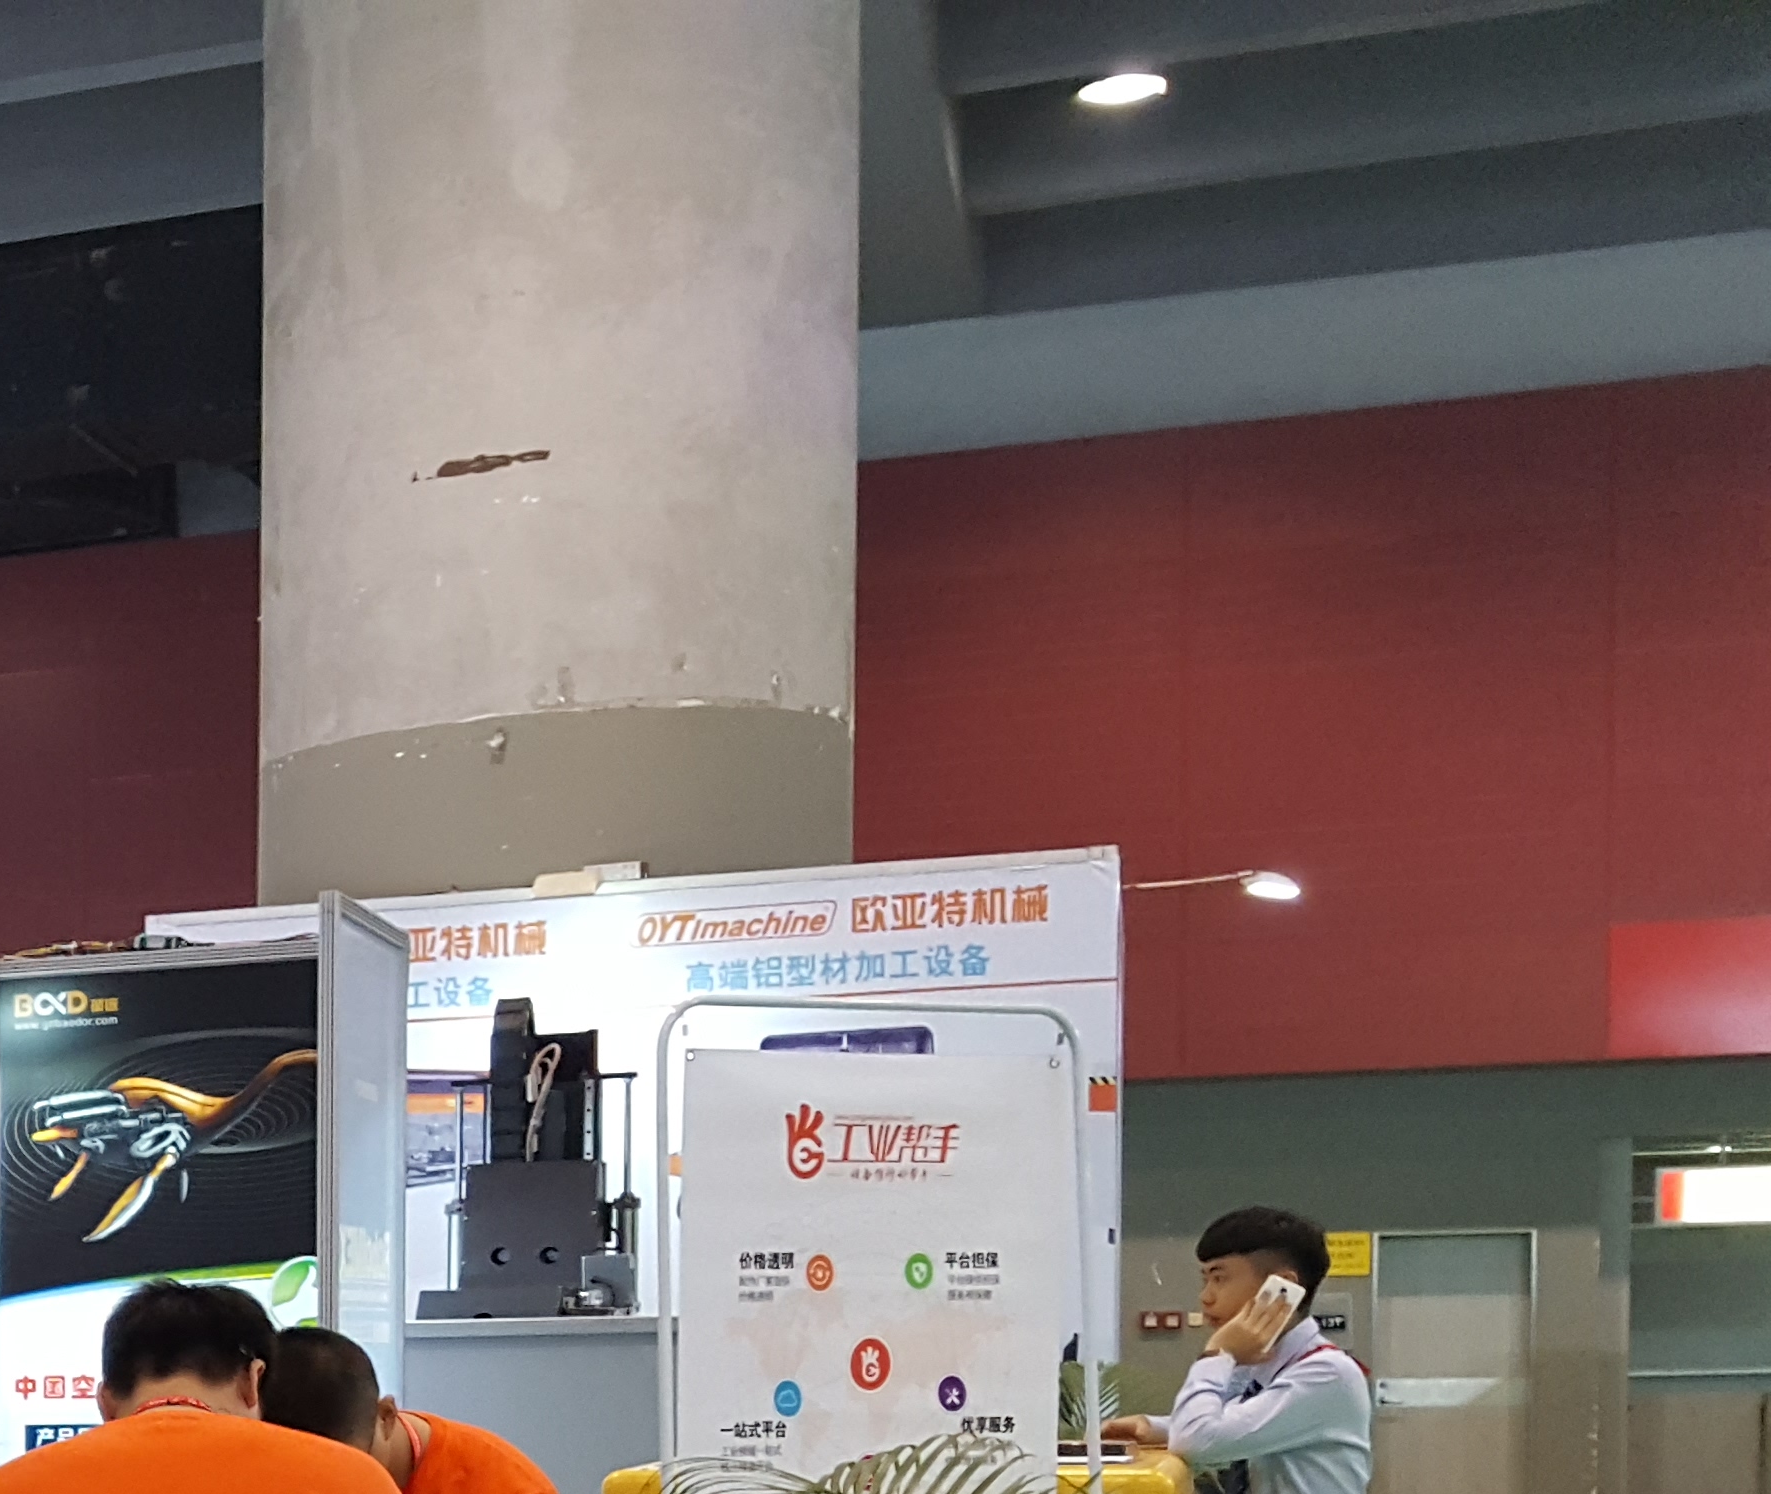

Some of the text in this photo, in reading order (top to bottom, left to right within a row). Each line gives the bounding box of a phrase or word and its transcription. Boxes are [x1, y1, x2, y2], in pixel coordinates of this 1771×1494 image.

[851, 884, 1049, 934] 欧亚特机械
[686, 945, 991, 992] 高端铝型材加工设备
[739, 1252, 795, 1270] 价格透明
[944, 1252, 999, 1270] 平台担保
